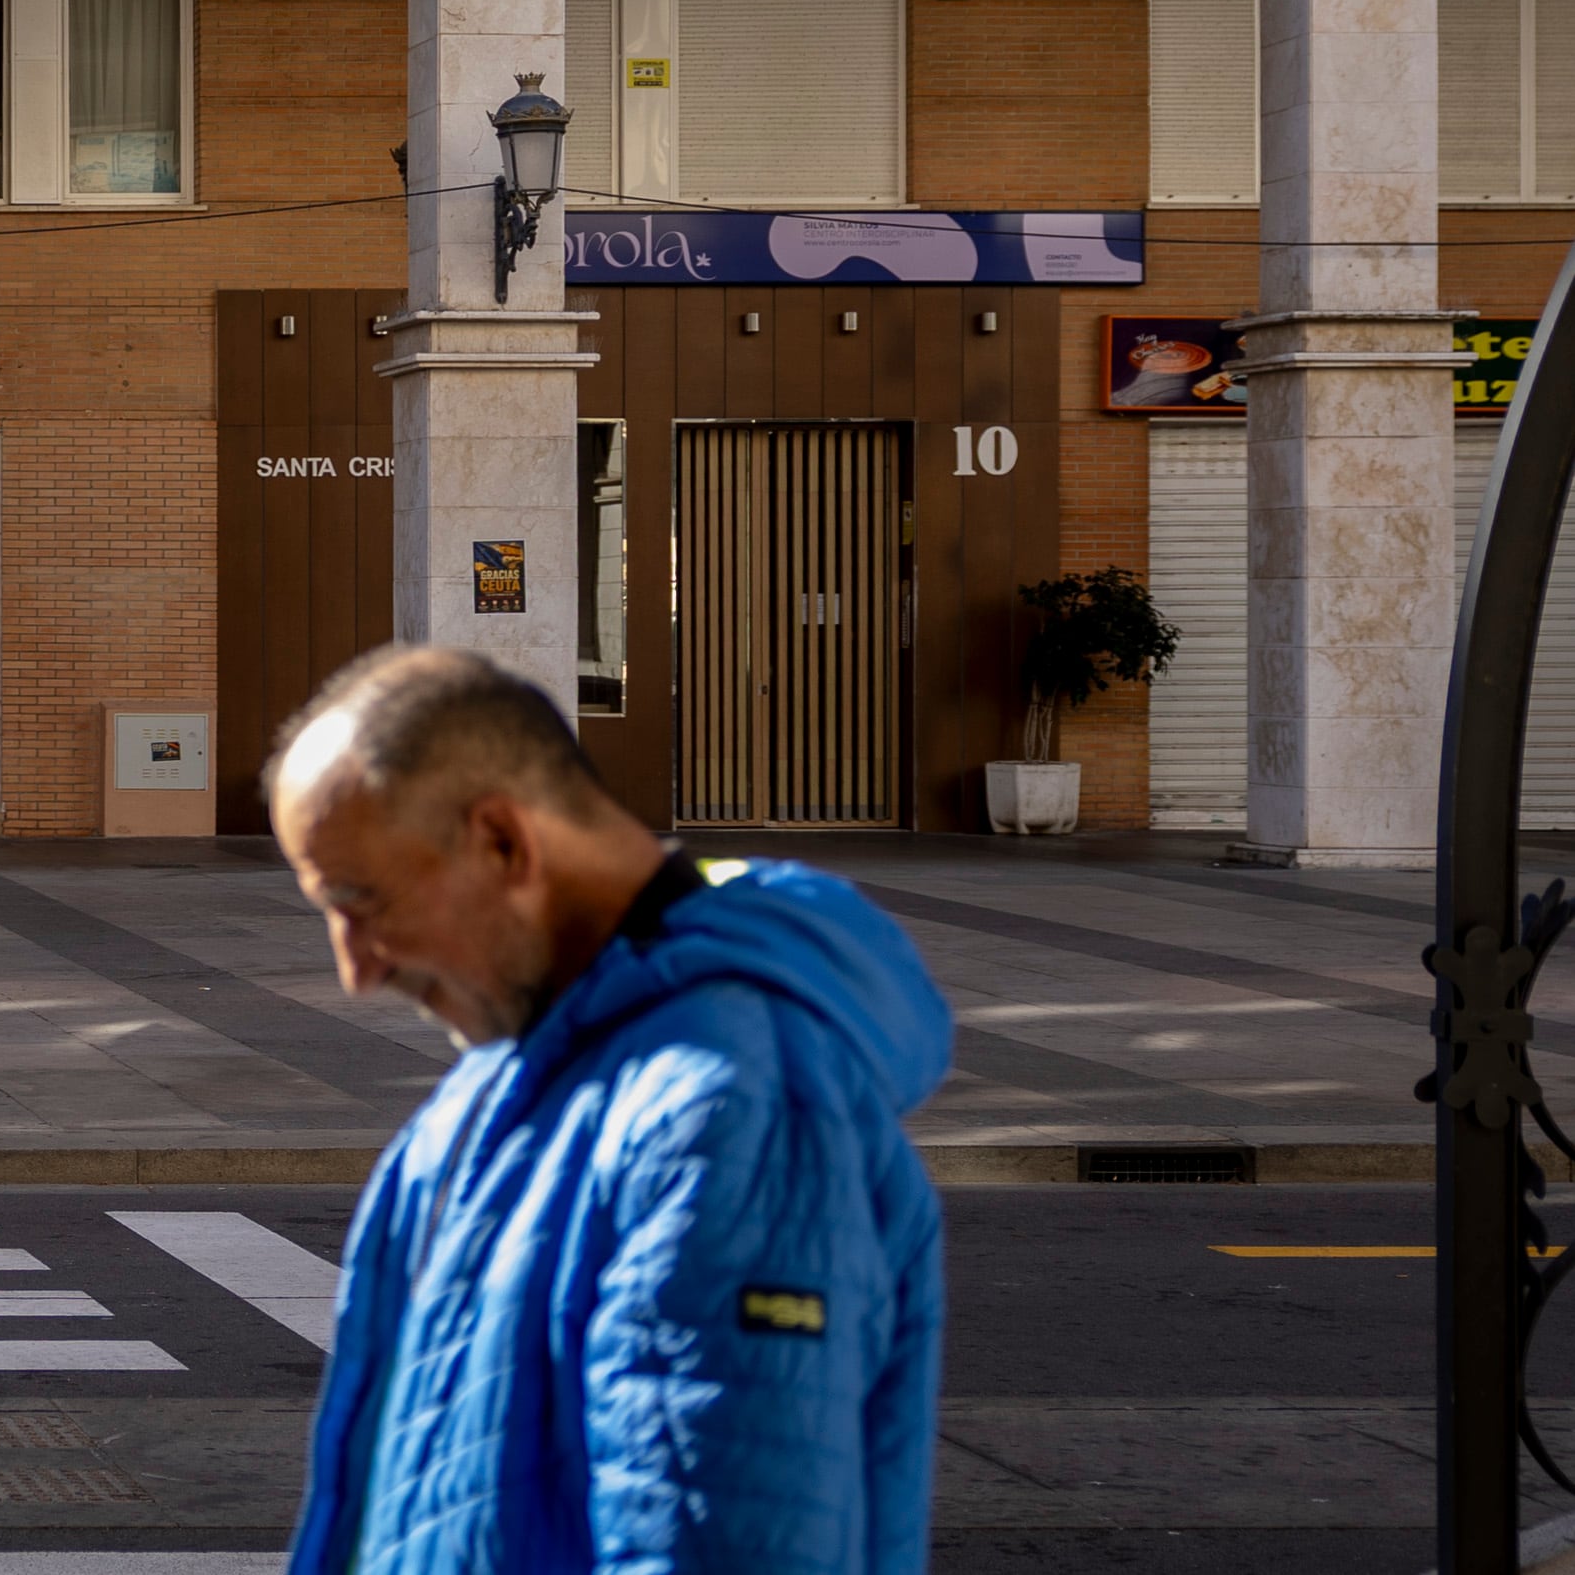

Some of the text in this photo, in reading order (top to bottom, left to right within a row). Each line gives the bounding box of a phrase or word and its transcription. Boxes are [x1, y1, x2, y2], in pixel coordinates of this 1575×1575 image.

[803, 221, 836, 230] SILVIA
[803, 230, 935, 238] CENTRO INTERDISCIPLINAR
[564, 215, 717, 281] rola
[951, 425, 1018, 476] 10
[256, 456, 395, 477] SANTA CRI
[480, 569, 520, 580] GRACIAS
[479, 579, 521, 592] CEUTA
